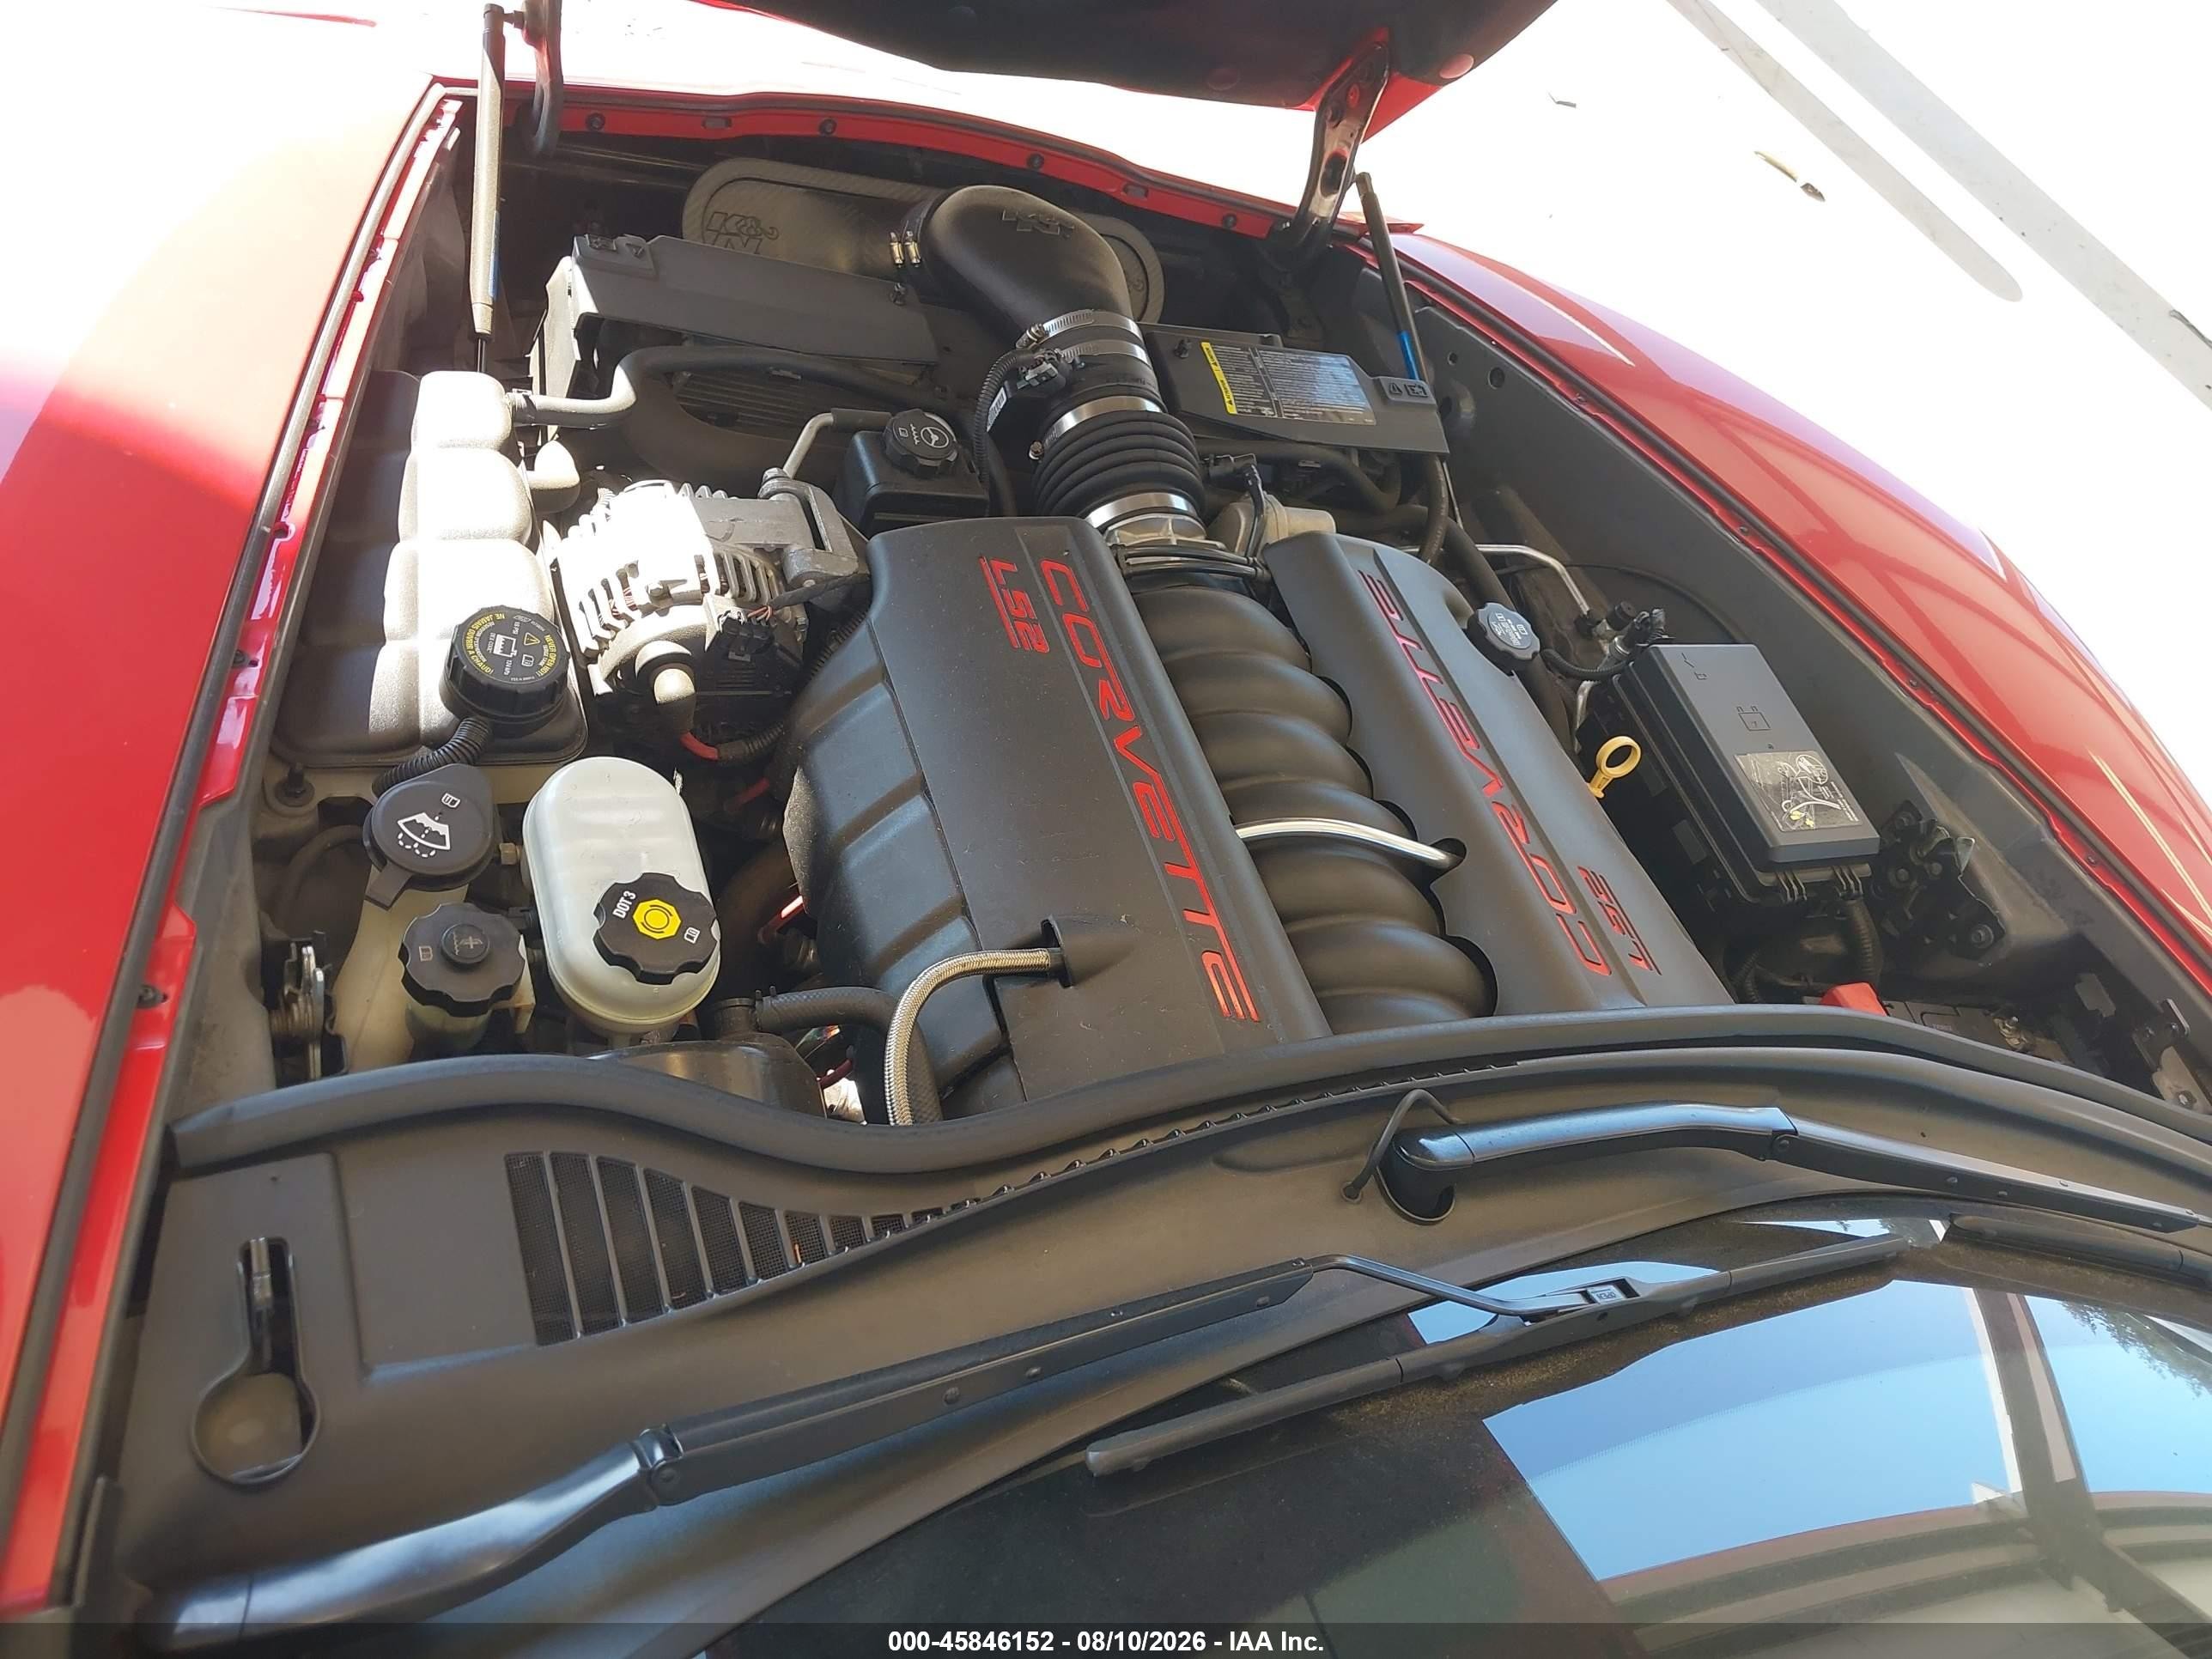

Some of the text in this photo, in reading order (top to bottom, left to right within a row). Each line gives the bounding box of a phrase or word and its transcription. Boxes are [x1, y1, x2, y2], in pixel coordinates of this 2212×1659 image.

[544, 634, 556, 653] NEVER
[988, 556, 1050, 654] LS2
[549, 653, 557, 667] OPEN
[1037, 557, 1261, 1024] CORVETTE
[1357, 568, 1613, 976] CORVETTE
[612, 890, 636, 919] DOT 3
[1577, 866, 1654, 971] LS2
